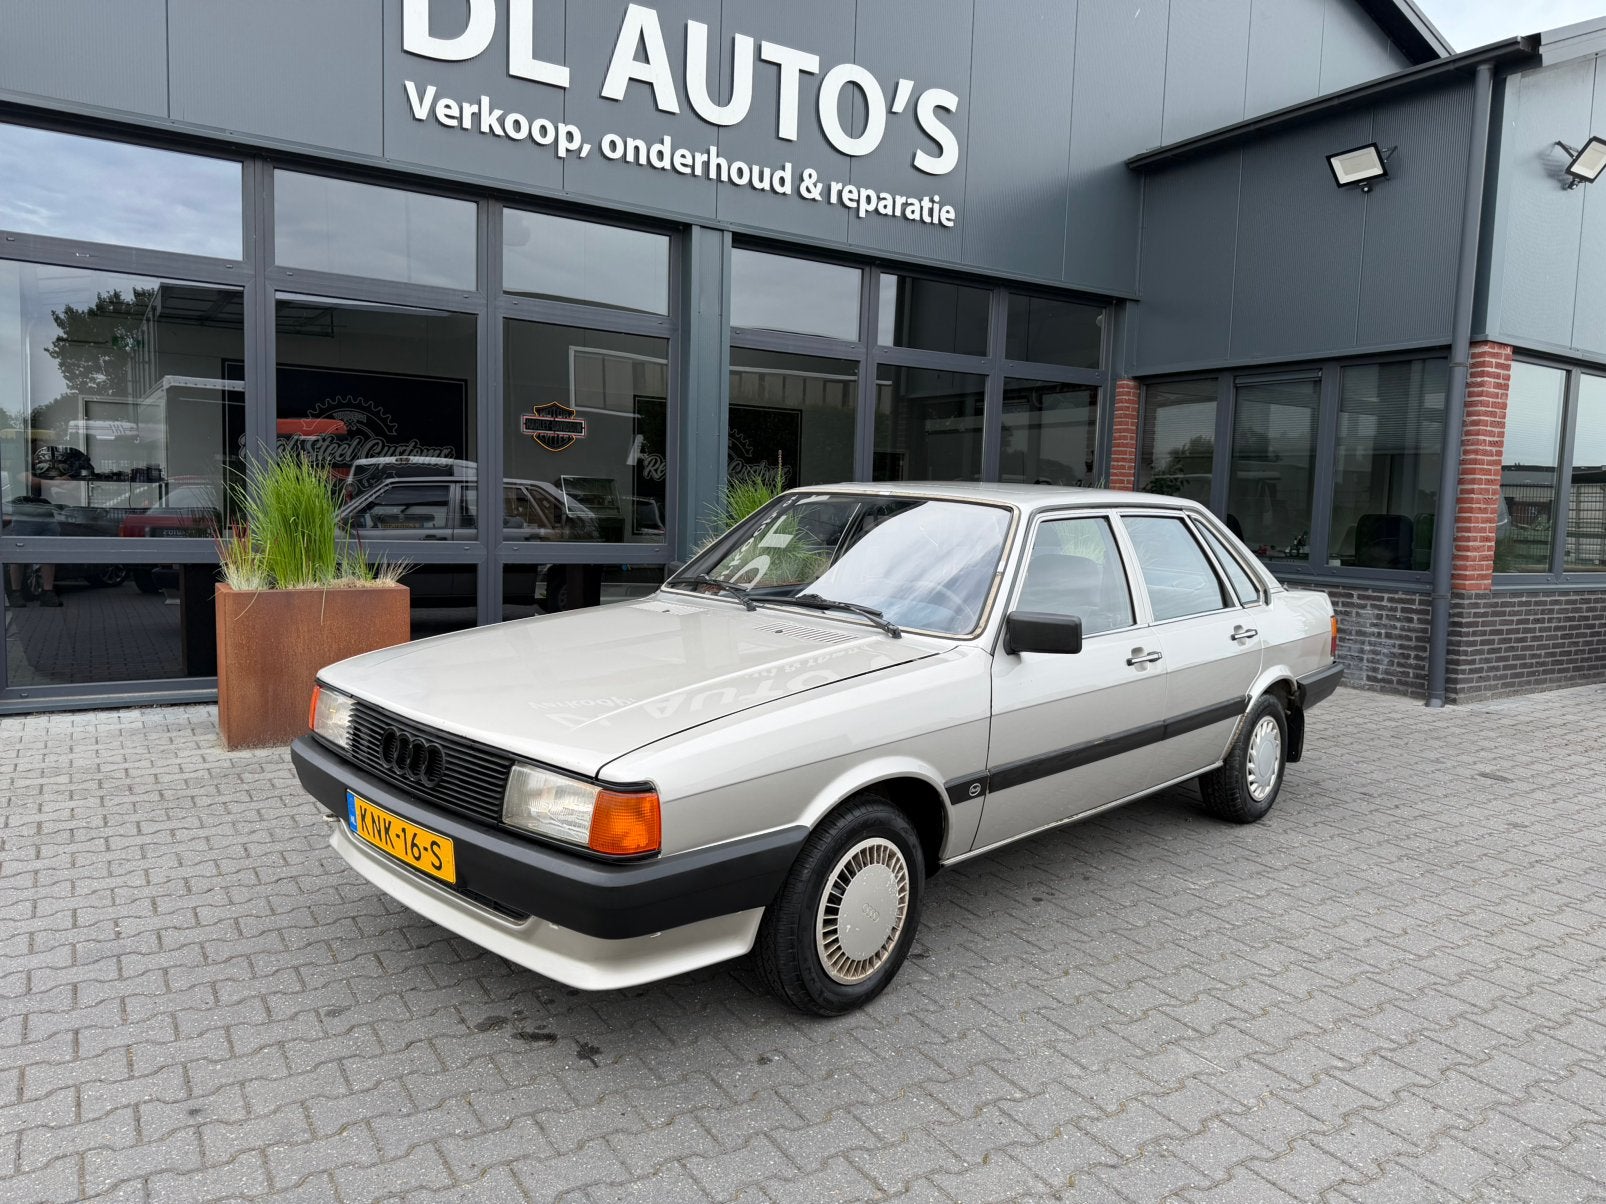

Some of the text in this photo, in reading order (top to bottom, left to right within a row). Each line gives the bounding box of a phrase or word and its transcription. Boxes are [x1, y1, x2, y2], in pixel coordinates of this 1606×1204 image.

[404, 80, 956, 227] Verkoop, onderhoud & reparatie
[601, 3, 959, 175] AUTO'S
[359, 804, 443, 871] KNK-16-S
